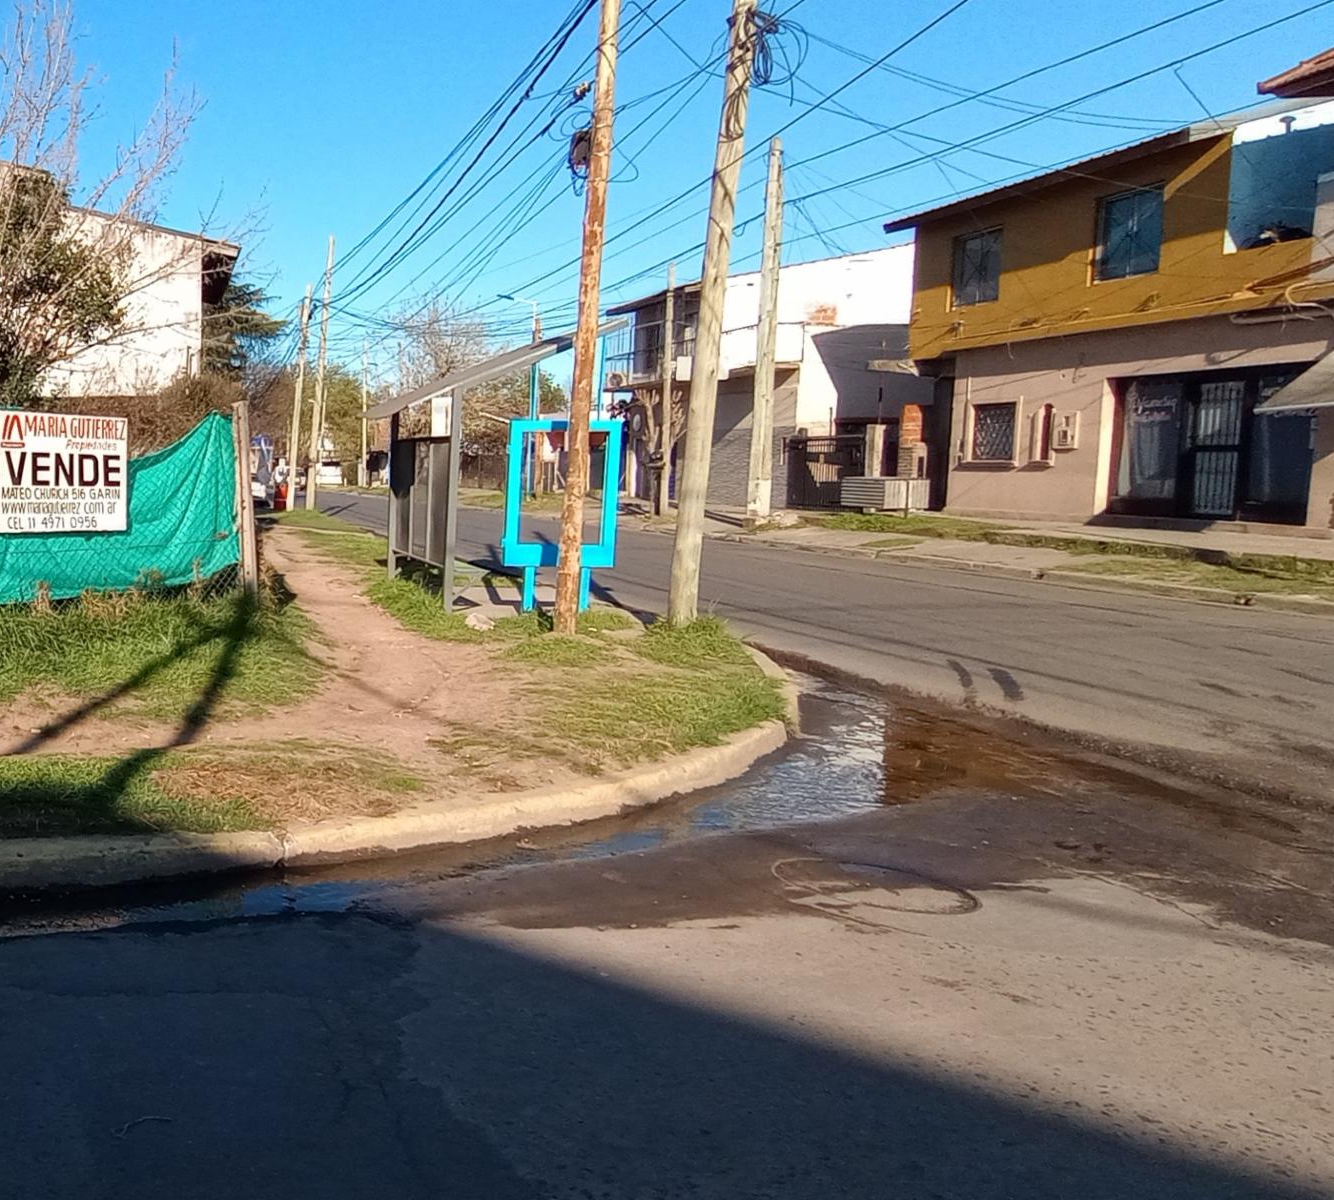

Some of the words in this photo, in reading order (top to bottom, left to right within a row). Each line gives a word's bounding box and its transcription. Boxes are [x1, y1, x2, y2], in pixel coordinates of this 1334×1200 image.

[24, 415, 67, 438] MARIA
[70, 417, 126, 440] GUTIERREZ
[5, 451, 121, 487] VENDE
[1, 487, 32, 500] MATEO
[34, 488, 69, 500] CHURCH
[72, 488, 86, 500] 516
[89, 488, 121, 500] GARIN
[7, 517, 24, 530] CEL
[28, 517, 36, 529] 11
[41, 516, 65, 529] 4971
[69, 516, 98, 529] 0956
